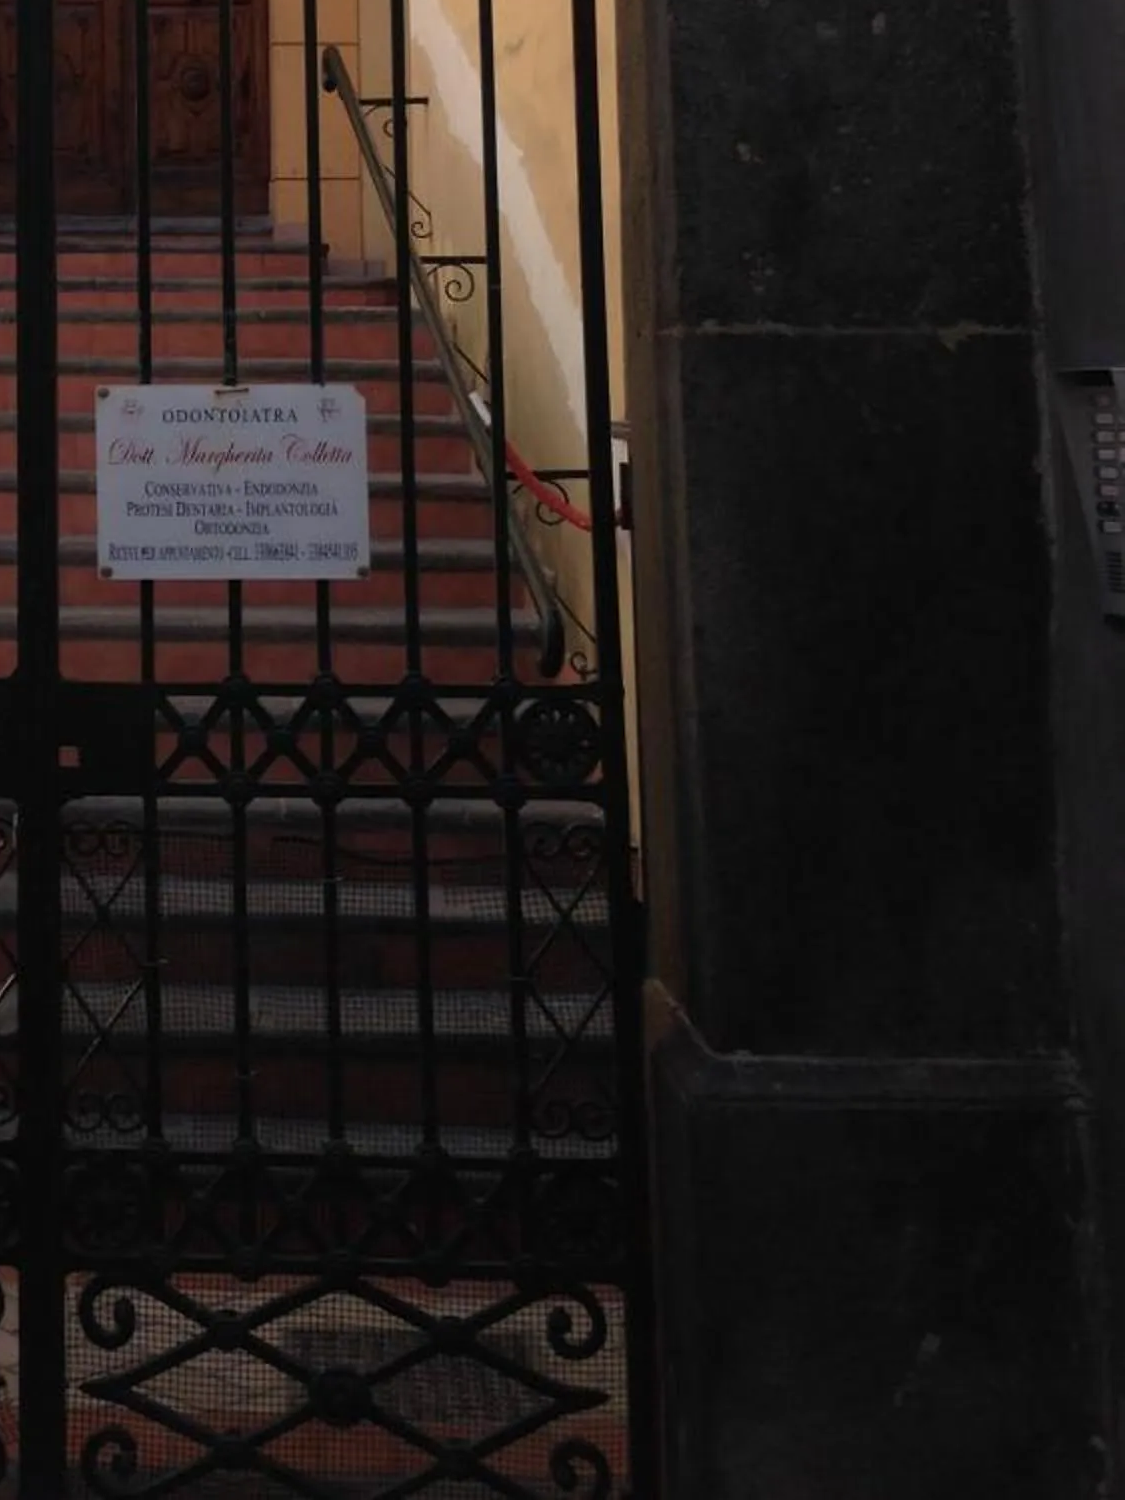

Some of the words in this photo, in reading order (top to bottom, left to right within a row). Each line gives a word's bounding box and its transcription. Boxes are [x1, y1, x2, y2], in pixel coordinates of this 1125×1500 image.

[161, 406, 298, 423] ODONTOIATRA
[166, 433, 274, 474] Margherita
[144, 481, 232, 497] CONSERVATIVA
[243, 481, 318, 497] ENDODONZIA
[194, 520, 269, 535] ORTODONZIA
